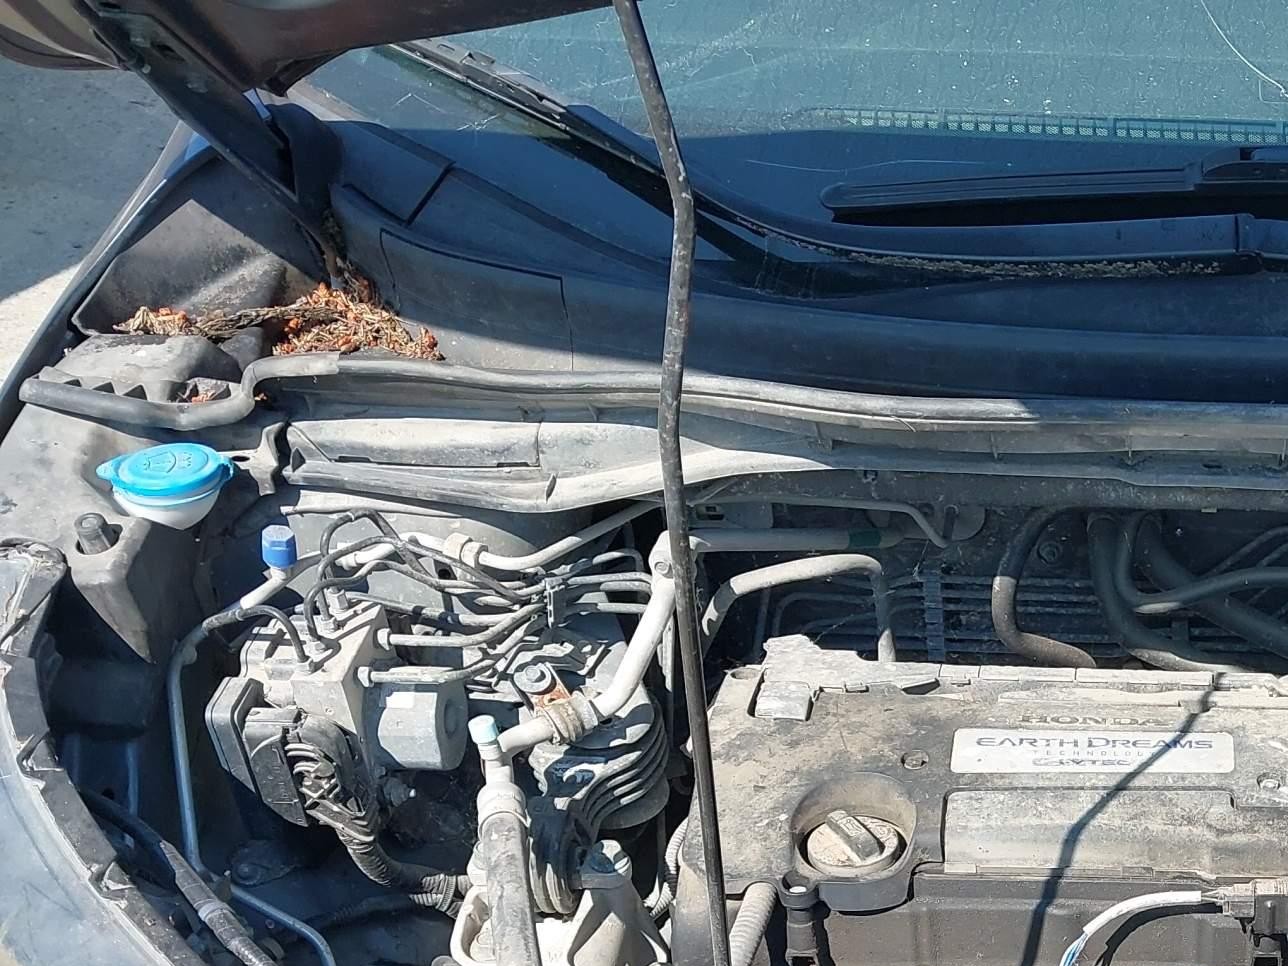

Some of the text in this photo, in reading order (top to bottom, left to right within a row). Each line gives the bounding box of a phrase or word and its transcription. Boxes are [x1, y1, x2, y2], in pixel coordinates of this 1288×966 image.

[1020, 714, 1169, 726] HONDA
[976, 736, 1213, 749] EARTH DREAMS
[1032, 749, 1156, 757] TECHNOLOGY
